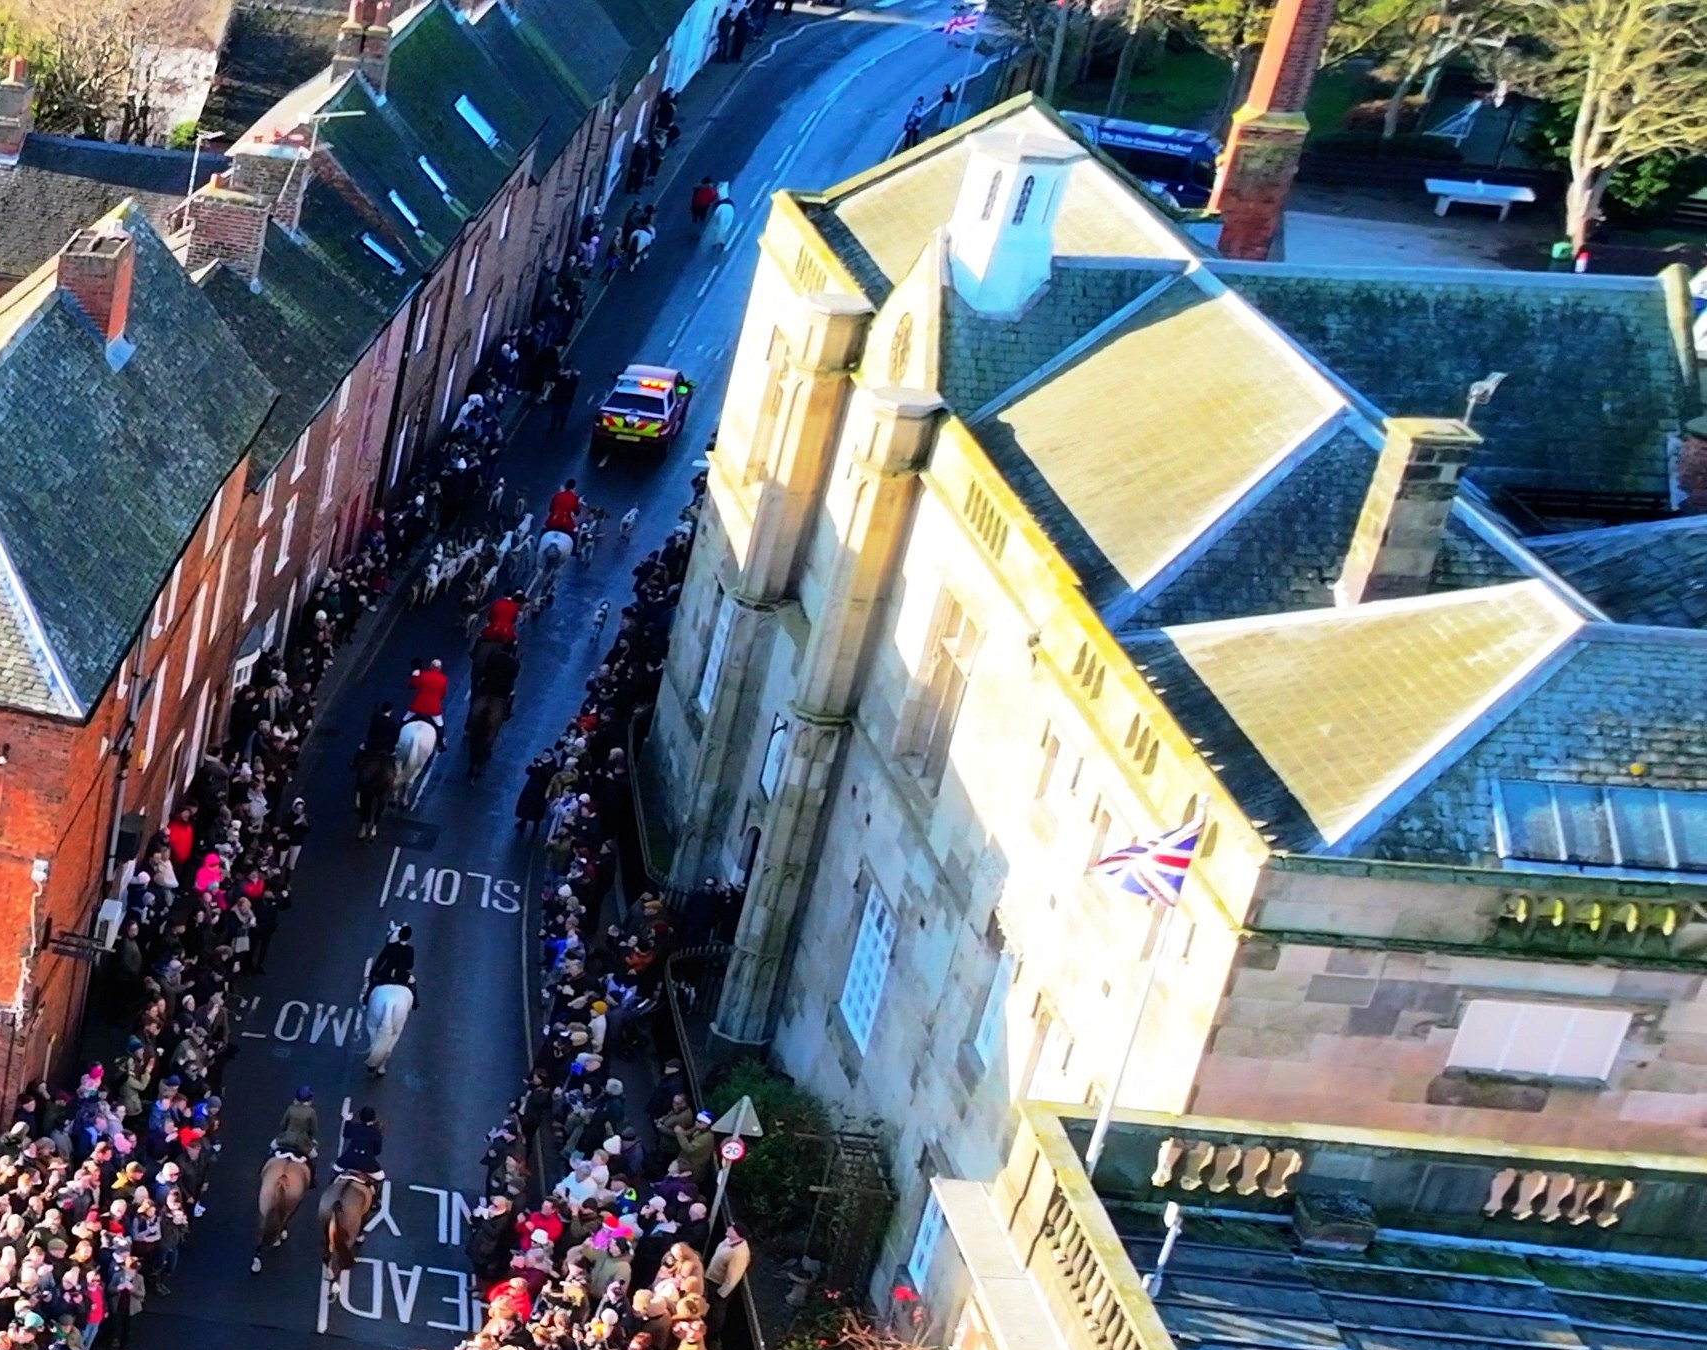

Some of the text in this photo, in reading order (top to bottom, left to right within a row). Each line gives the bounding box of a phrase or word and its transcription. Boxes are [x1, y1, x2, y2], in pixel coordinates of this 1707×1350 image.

[394, 863, 521, 914] SLOW
[231, 994, 354, 1048] LOW
[724, 1145, 741, 1156] 20
[363, 1180, 487, 1246] NLY
